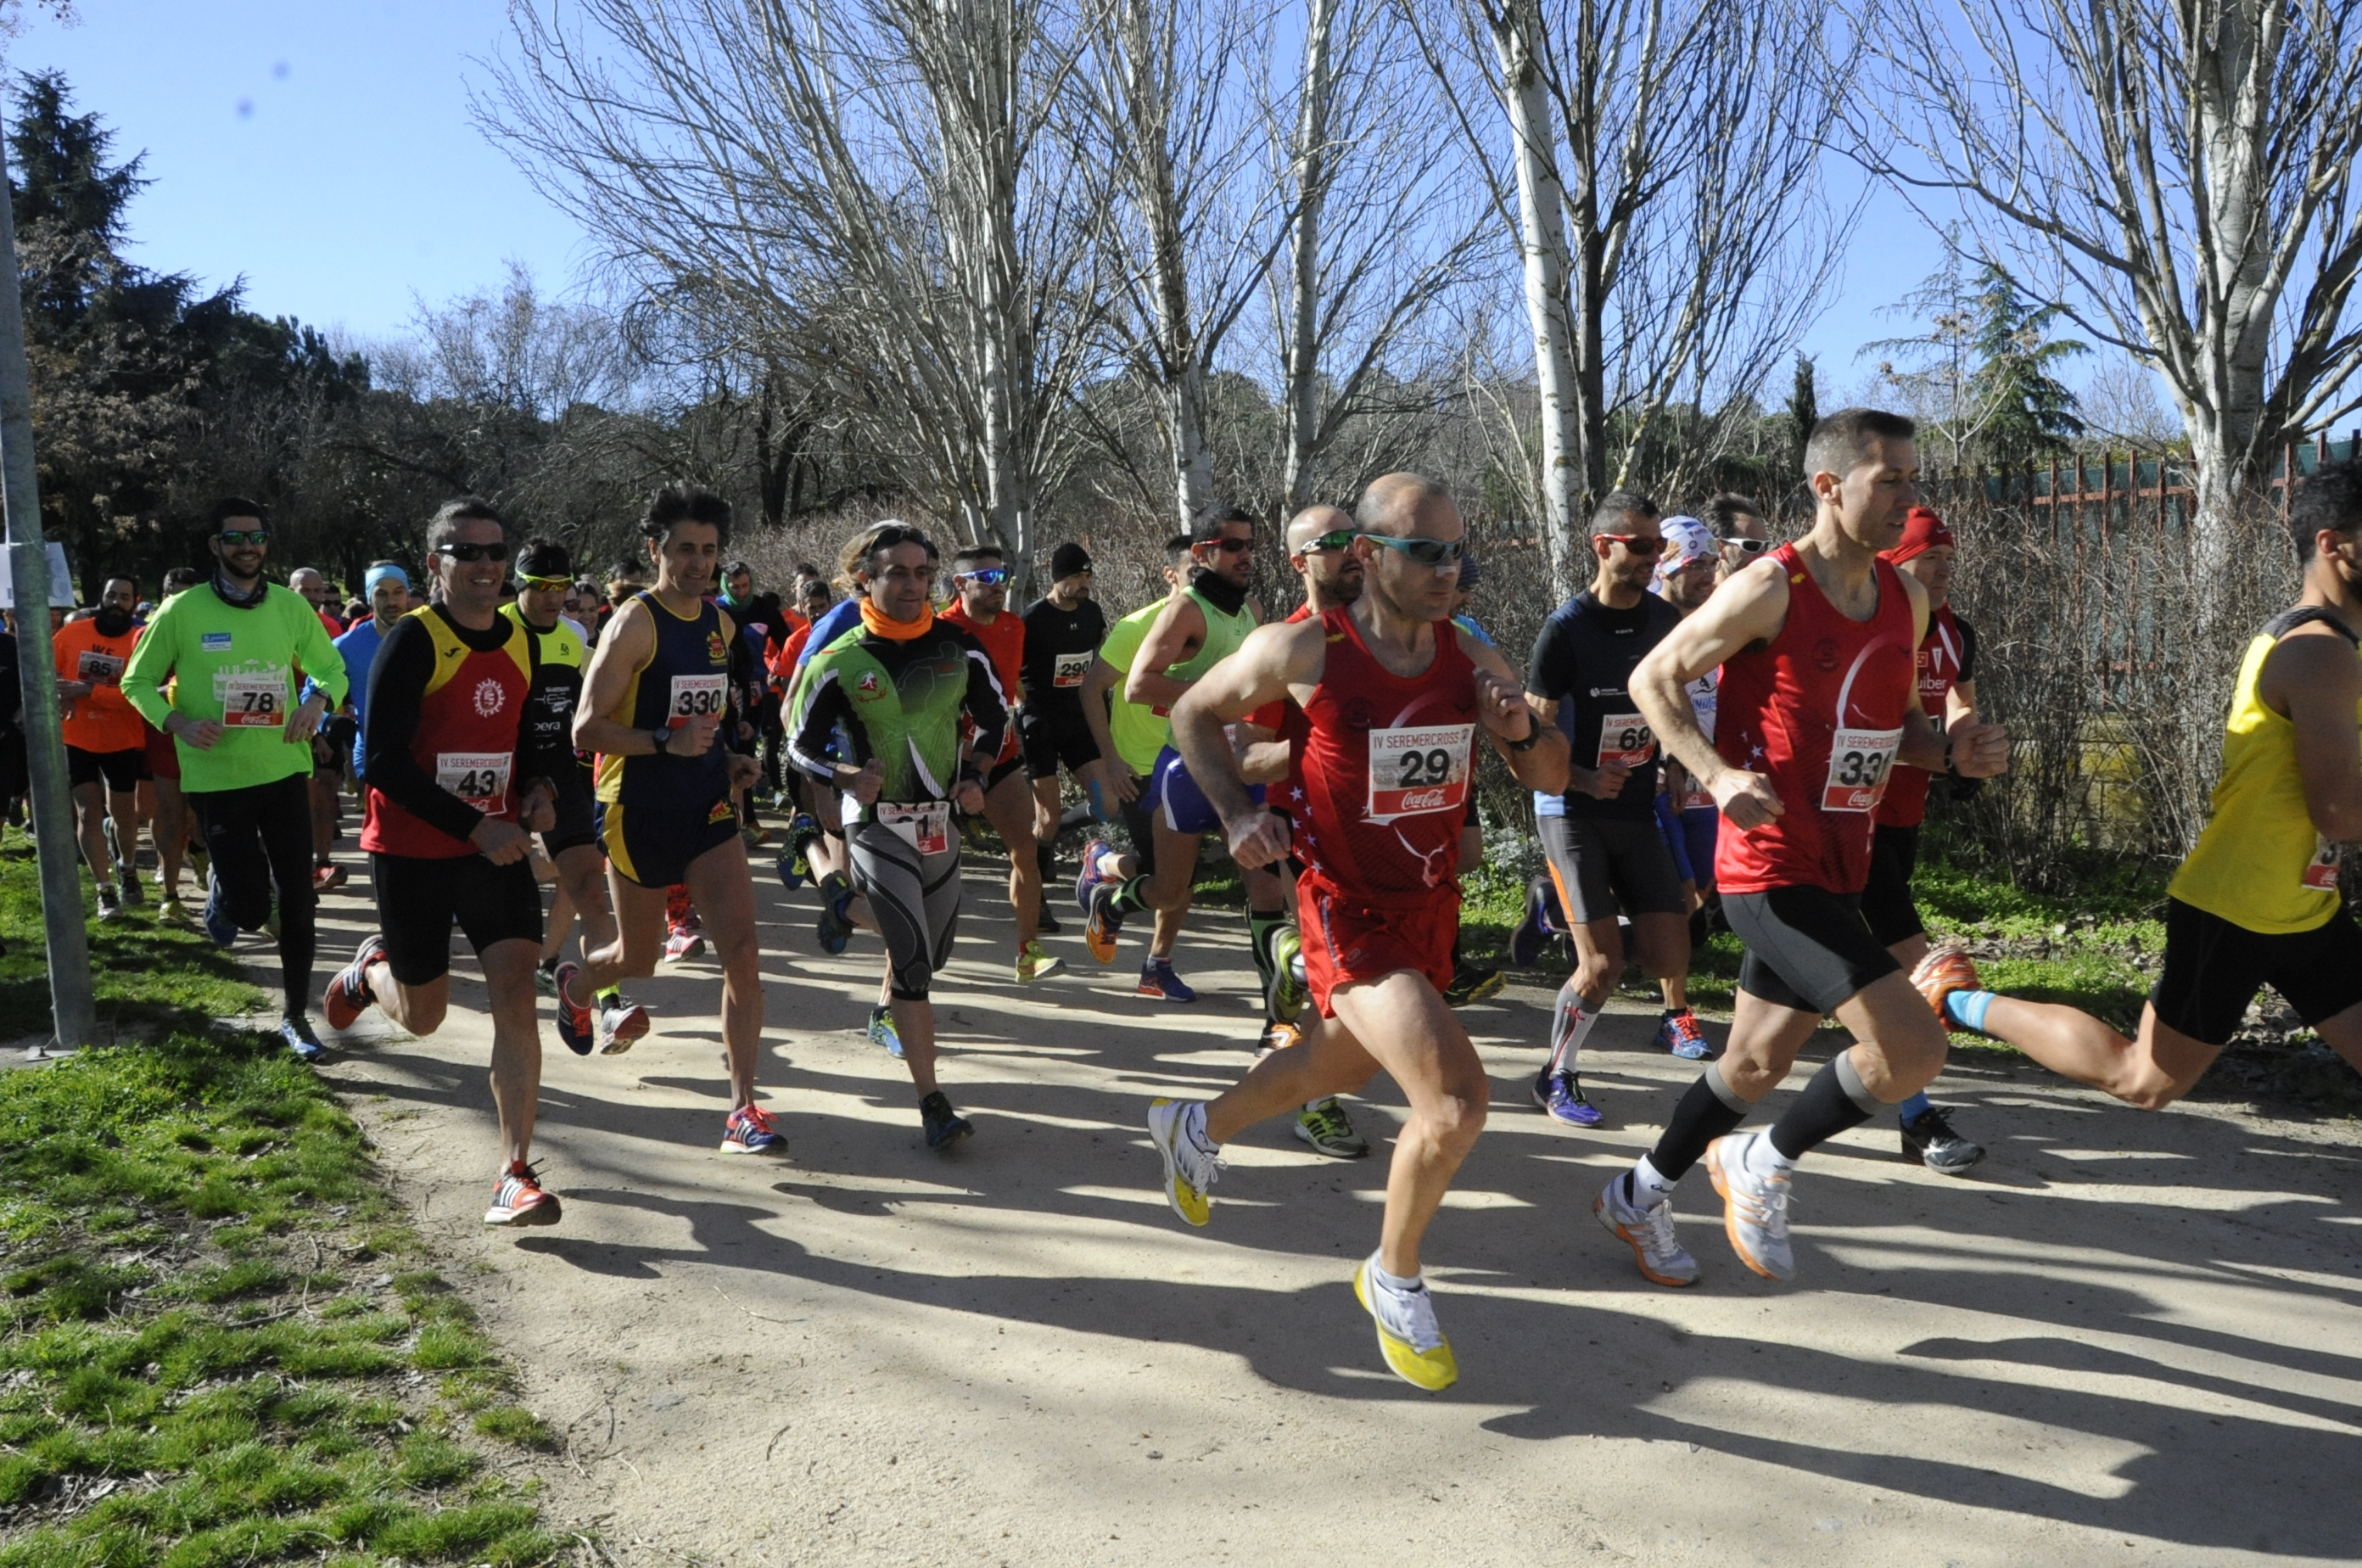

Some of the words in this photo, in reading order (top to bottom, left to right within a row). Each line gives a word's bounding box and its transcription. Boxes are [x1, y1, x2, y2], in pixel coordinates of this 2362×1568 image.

[89, 660, 111, 675] 85
[1061, 660, 1090, 676] 290
[243, 692, 274, 712] 78
[678, 689, 721, 716] 330
[1374, 736, 1383, 749] IV
[1387, 731, 1459, 748] SEREMERCROSS
[1620, 725, 1651, 751] 69
[1837, 736, 1846, 747] IV
[440, 758, 448, 768] IV
[451, 758, 502, 768] SEREMERCROSS
[1400, 748, 1449, 787] 29
[458, 770, 495, 796] 43
